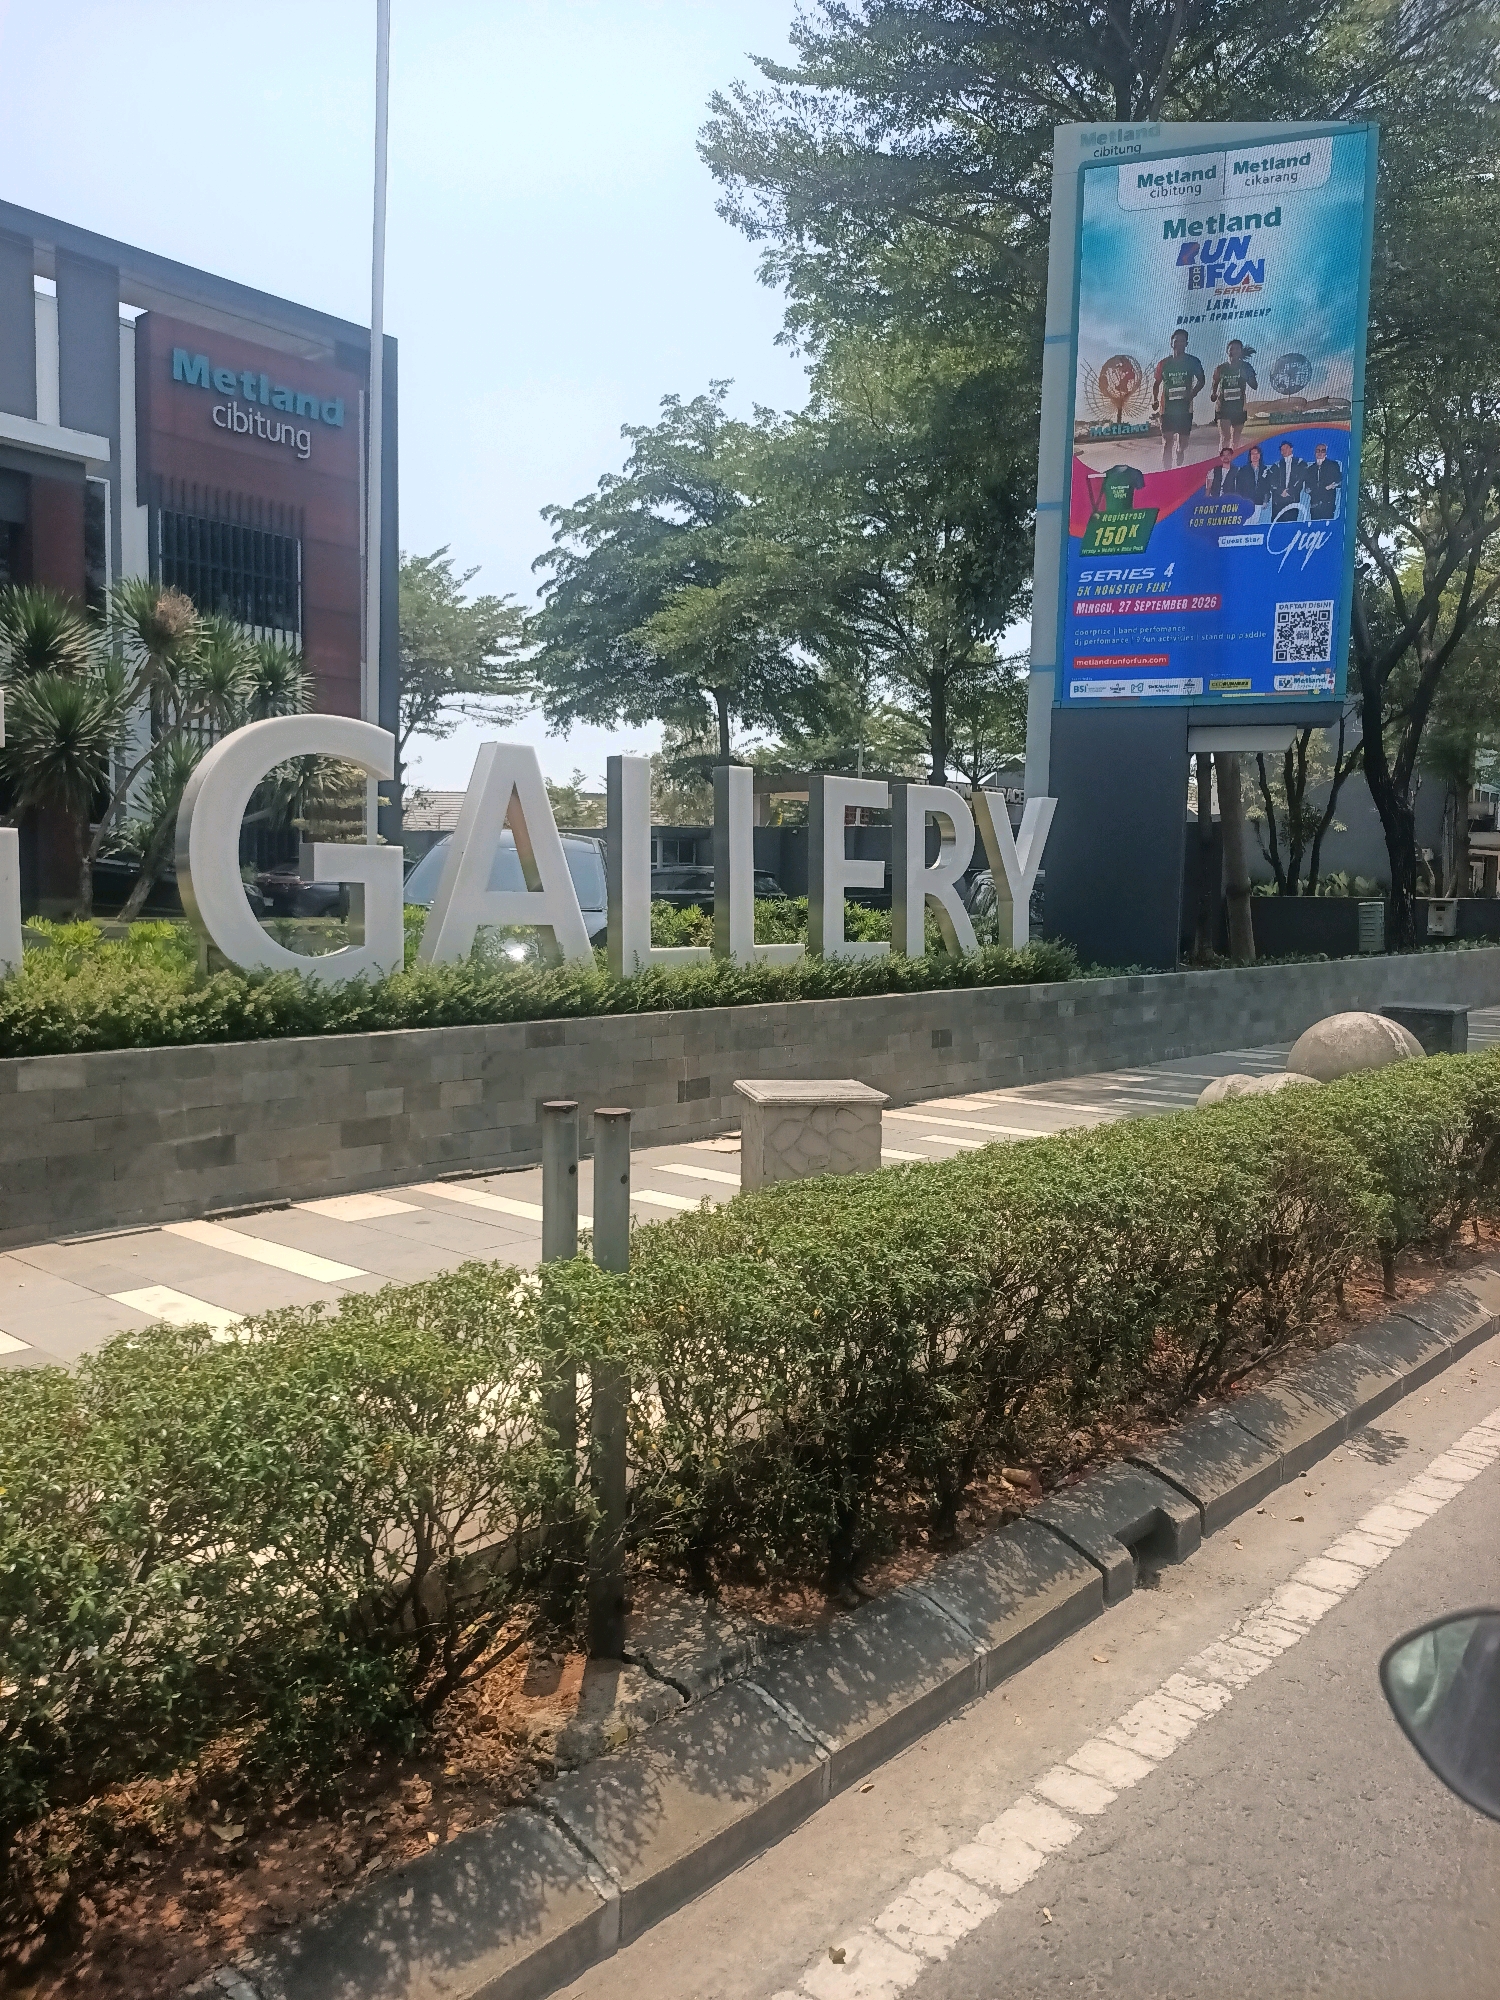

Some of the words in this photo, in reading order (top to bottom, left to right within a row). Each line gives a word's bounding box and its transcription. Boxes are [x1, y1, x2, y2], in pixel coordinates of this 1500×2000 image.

[1081, 123, 1160, 147] Metland
[1094, 144, 1141, 158] cibitung
[1233, 152, 1311, 175] Metland
[1137, 165, 1217, 189] Metland
[1244, 169, 1298, 187] cikarang
[1150, 184, 1202, 199] cibitung
[1163, 206, 1282, 240] Metland
[1176, 235, 1251, 266] RUN
[1192, 266, 1202, 289] FOR
[1206, 259, 1265, 288] FUN
[1214, 284, 1262, 296] SERIES
[1176, 315, 1206, 325] DAPAT
[1209, 308, 1271, 321] APARTEMEN?
[172, 347, 345, 428] Metland
[212, 401, 311, 459] cibitung
[1089, 421, 1149, 437] Metland
[1102, 511, 1146, 523] Registrasi
[1194, 504, 1219, 515] FRONT
[1220, 503, 1239, 513] ROW
[1190, 518, 1204, 528] FOR
[1207, 515, 1243, 527] RUNNERS
[1221, 537, 1243, 545] Guest
[1244, 536, 1260, 544] Star
[1078, 567, 1156, 583] SERIES
[1163, 562, 1175, 578] 4
[1077, 586, 1092, 597] 5K
[1094, 583, 1143, 596] NONSTOP
[1146, 581, 1171, 593] FUN!
[1119, 601, 1131, 613] 27
[1191, 596, 1217, 609] 2026
[1074, 638, 1082, 647] dj
[1201, 633, 1224, 641] stand
[1226, 633, 1235, 641] up
[1238, 631, 1267, 640] paddle
[1076, 656, 1167, 666] metlandrunforfun.com
[1073, 685, 1087, 694] BSI
[175, 713, 1058, 984] GALLERY
